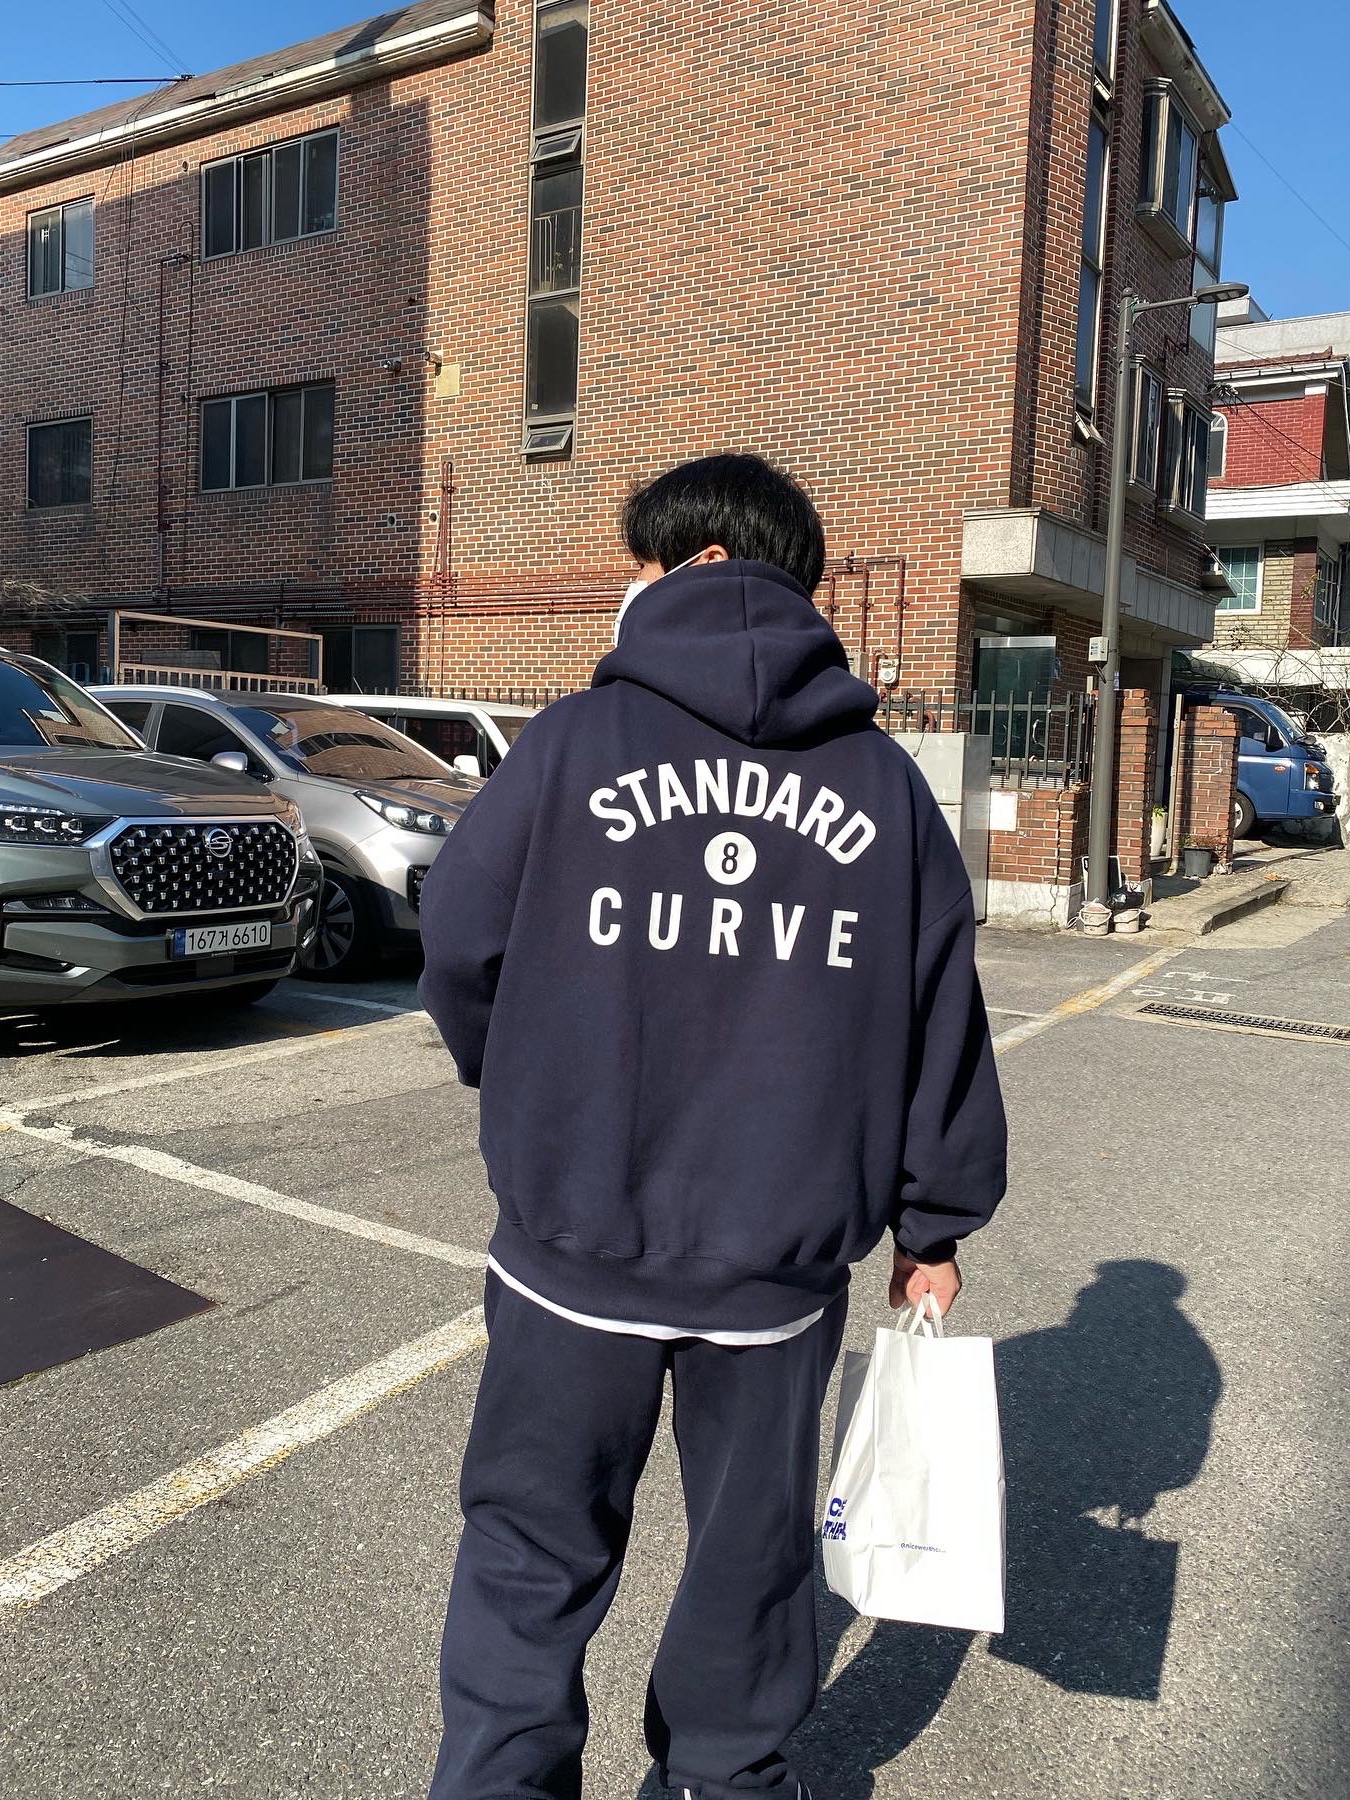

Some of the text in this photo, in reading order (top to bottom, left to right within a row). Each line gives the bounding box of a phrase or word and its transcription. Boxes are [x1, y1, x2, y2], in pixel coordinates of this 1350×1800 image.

[588, 758, 877, 865] STANDARD
[721, 842, 739, 875] 8
[232, 924, 268, 946] 6610
[588, 886, 859, 969] CURVE
